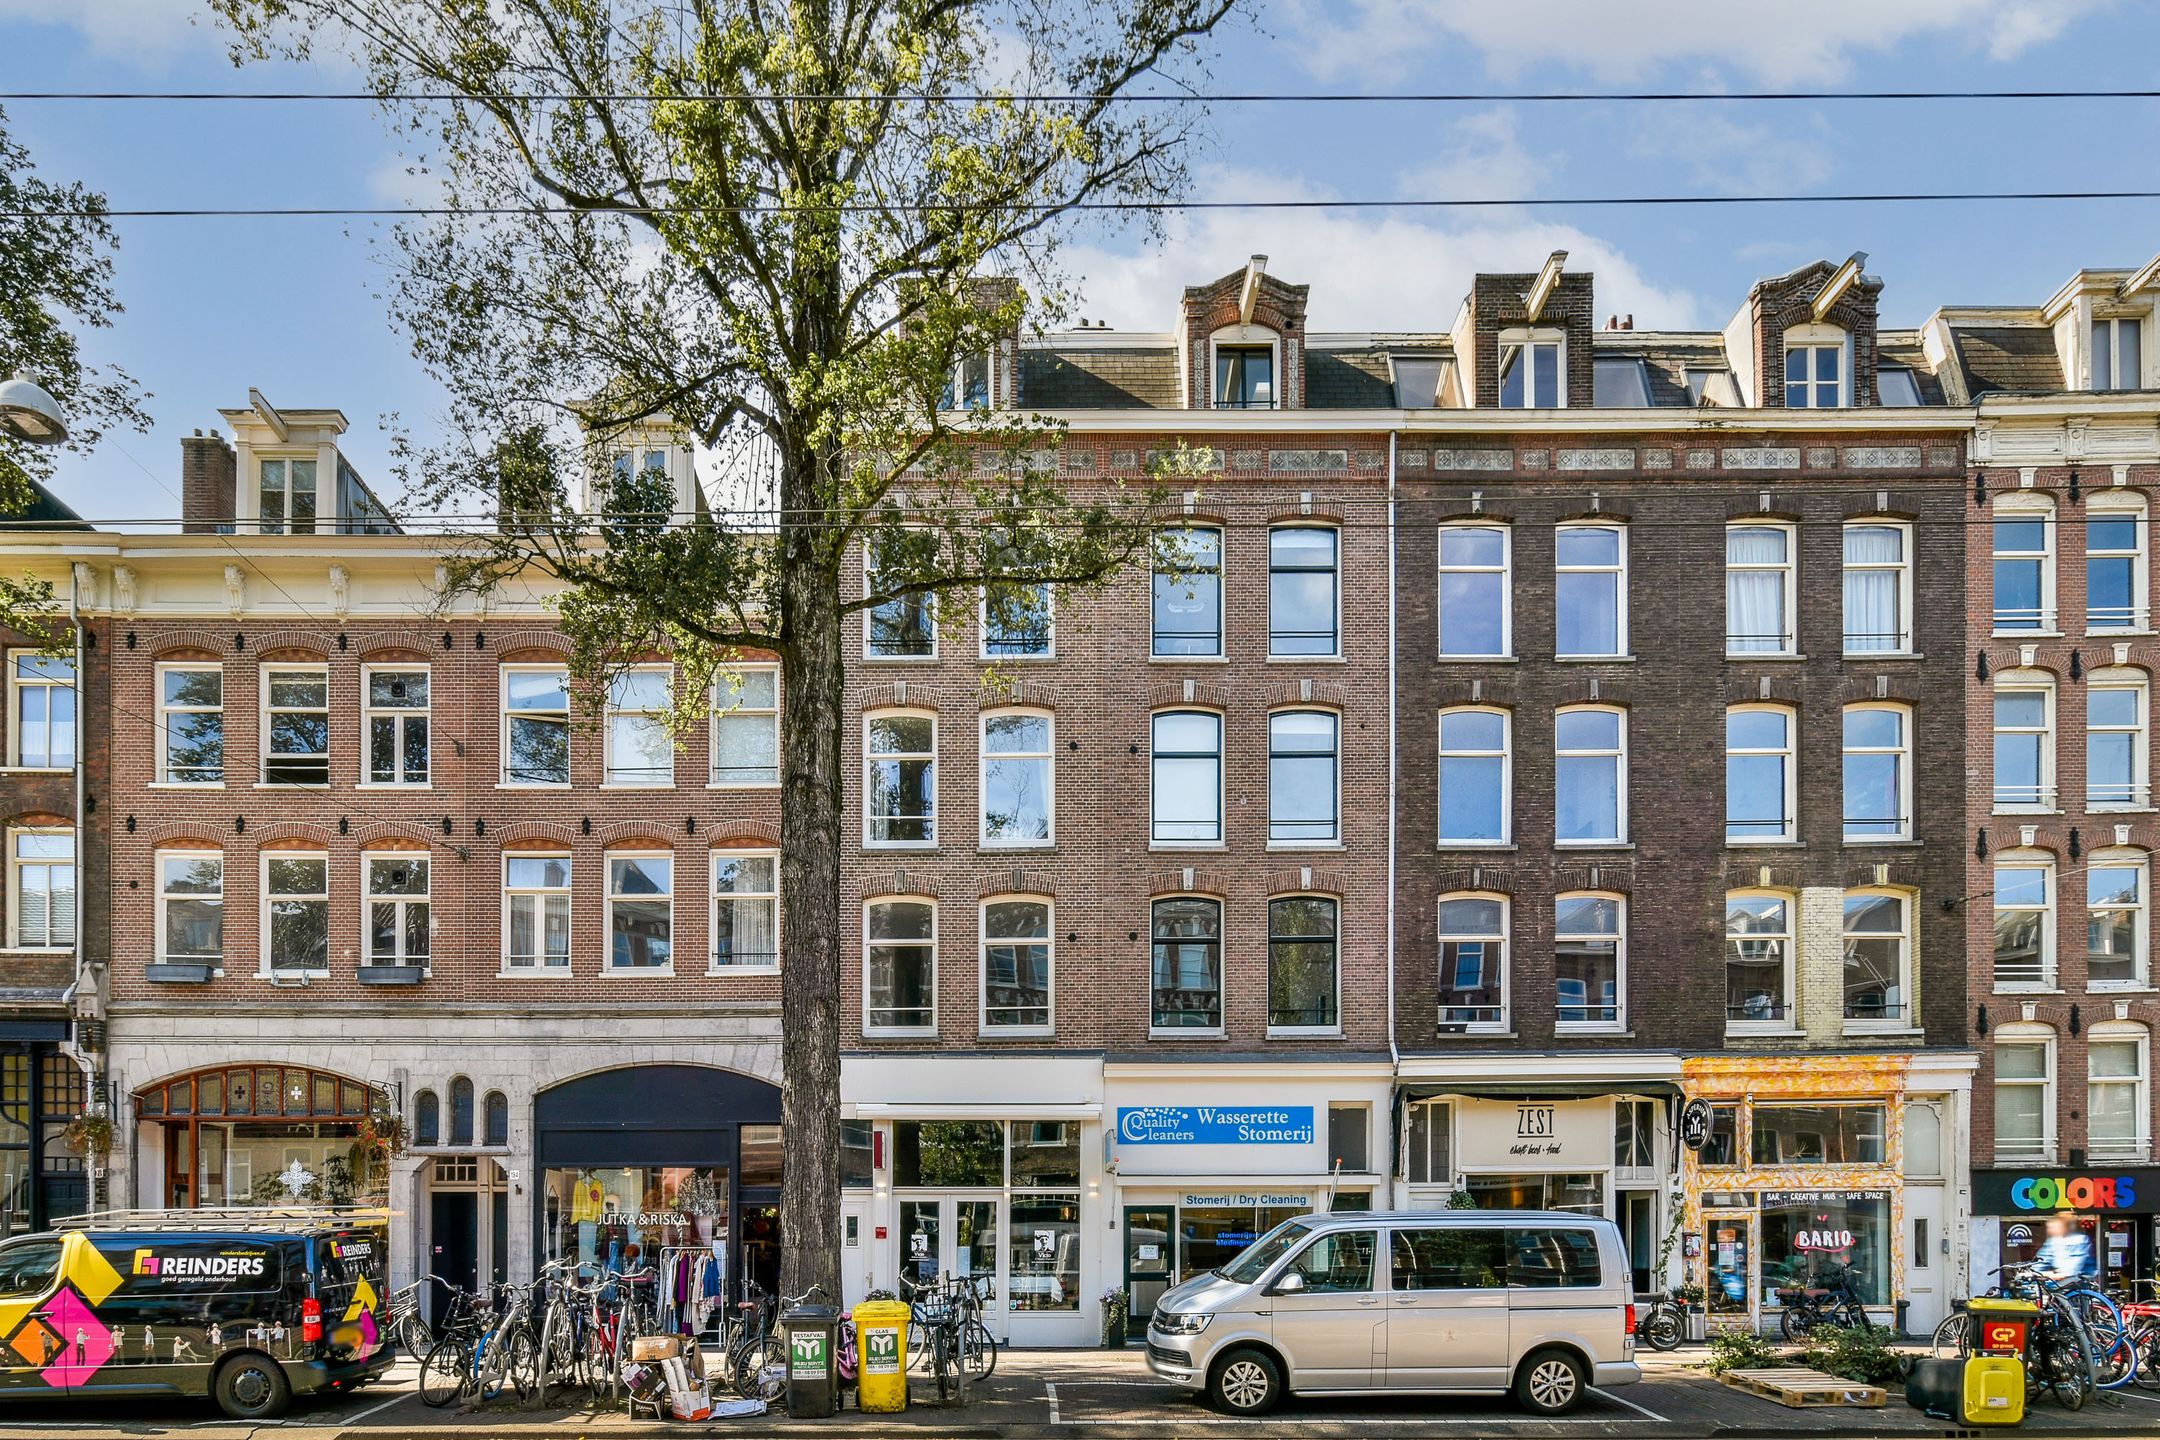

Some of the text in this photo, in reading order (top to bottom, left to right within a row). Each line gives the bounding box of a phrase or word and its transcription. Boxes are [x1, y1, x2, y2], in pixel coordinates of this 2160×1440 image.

[1131, 1115, 1180, 1129] Quality
[1197, 1108, 1289, 1124] Wasserette
[1517, 1109, 1554, 1134] ZEST
[1238, 1125, 1312, 1144] Stomerij
[1186, 1195, 1230, 1206] Stomerij
[1239, 1195, 1258, 1206] Dry
[1260, 1194, 1307, 1206] Cleaning
[1766, 1192, 1780, 1200] BAR
[1790, 1192, 1819, 1200] CREATIVE
[1822, 1192, 1836, 1200] HUB
[1864, 1192, 1884, 1200] SPACE
[2011, 1176, 2138, 1210] COLORS
[598, 1214, 686, 1225] JUTKA & RISKA
[1799, 1230, 1851, 1247] BARIO
[341, 1243, 372, 1257] REINDERS
[162, 1257, 264, 1275] REINDERS
[161, 1275, 177, 1283] goed
[177, 1275, 204, 1283] geregeld
